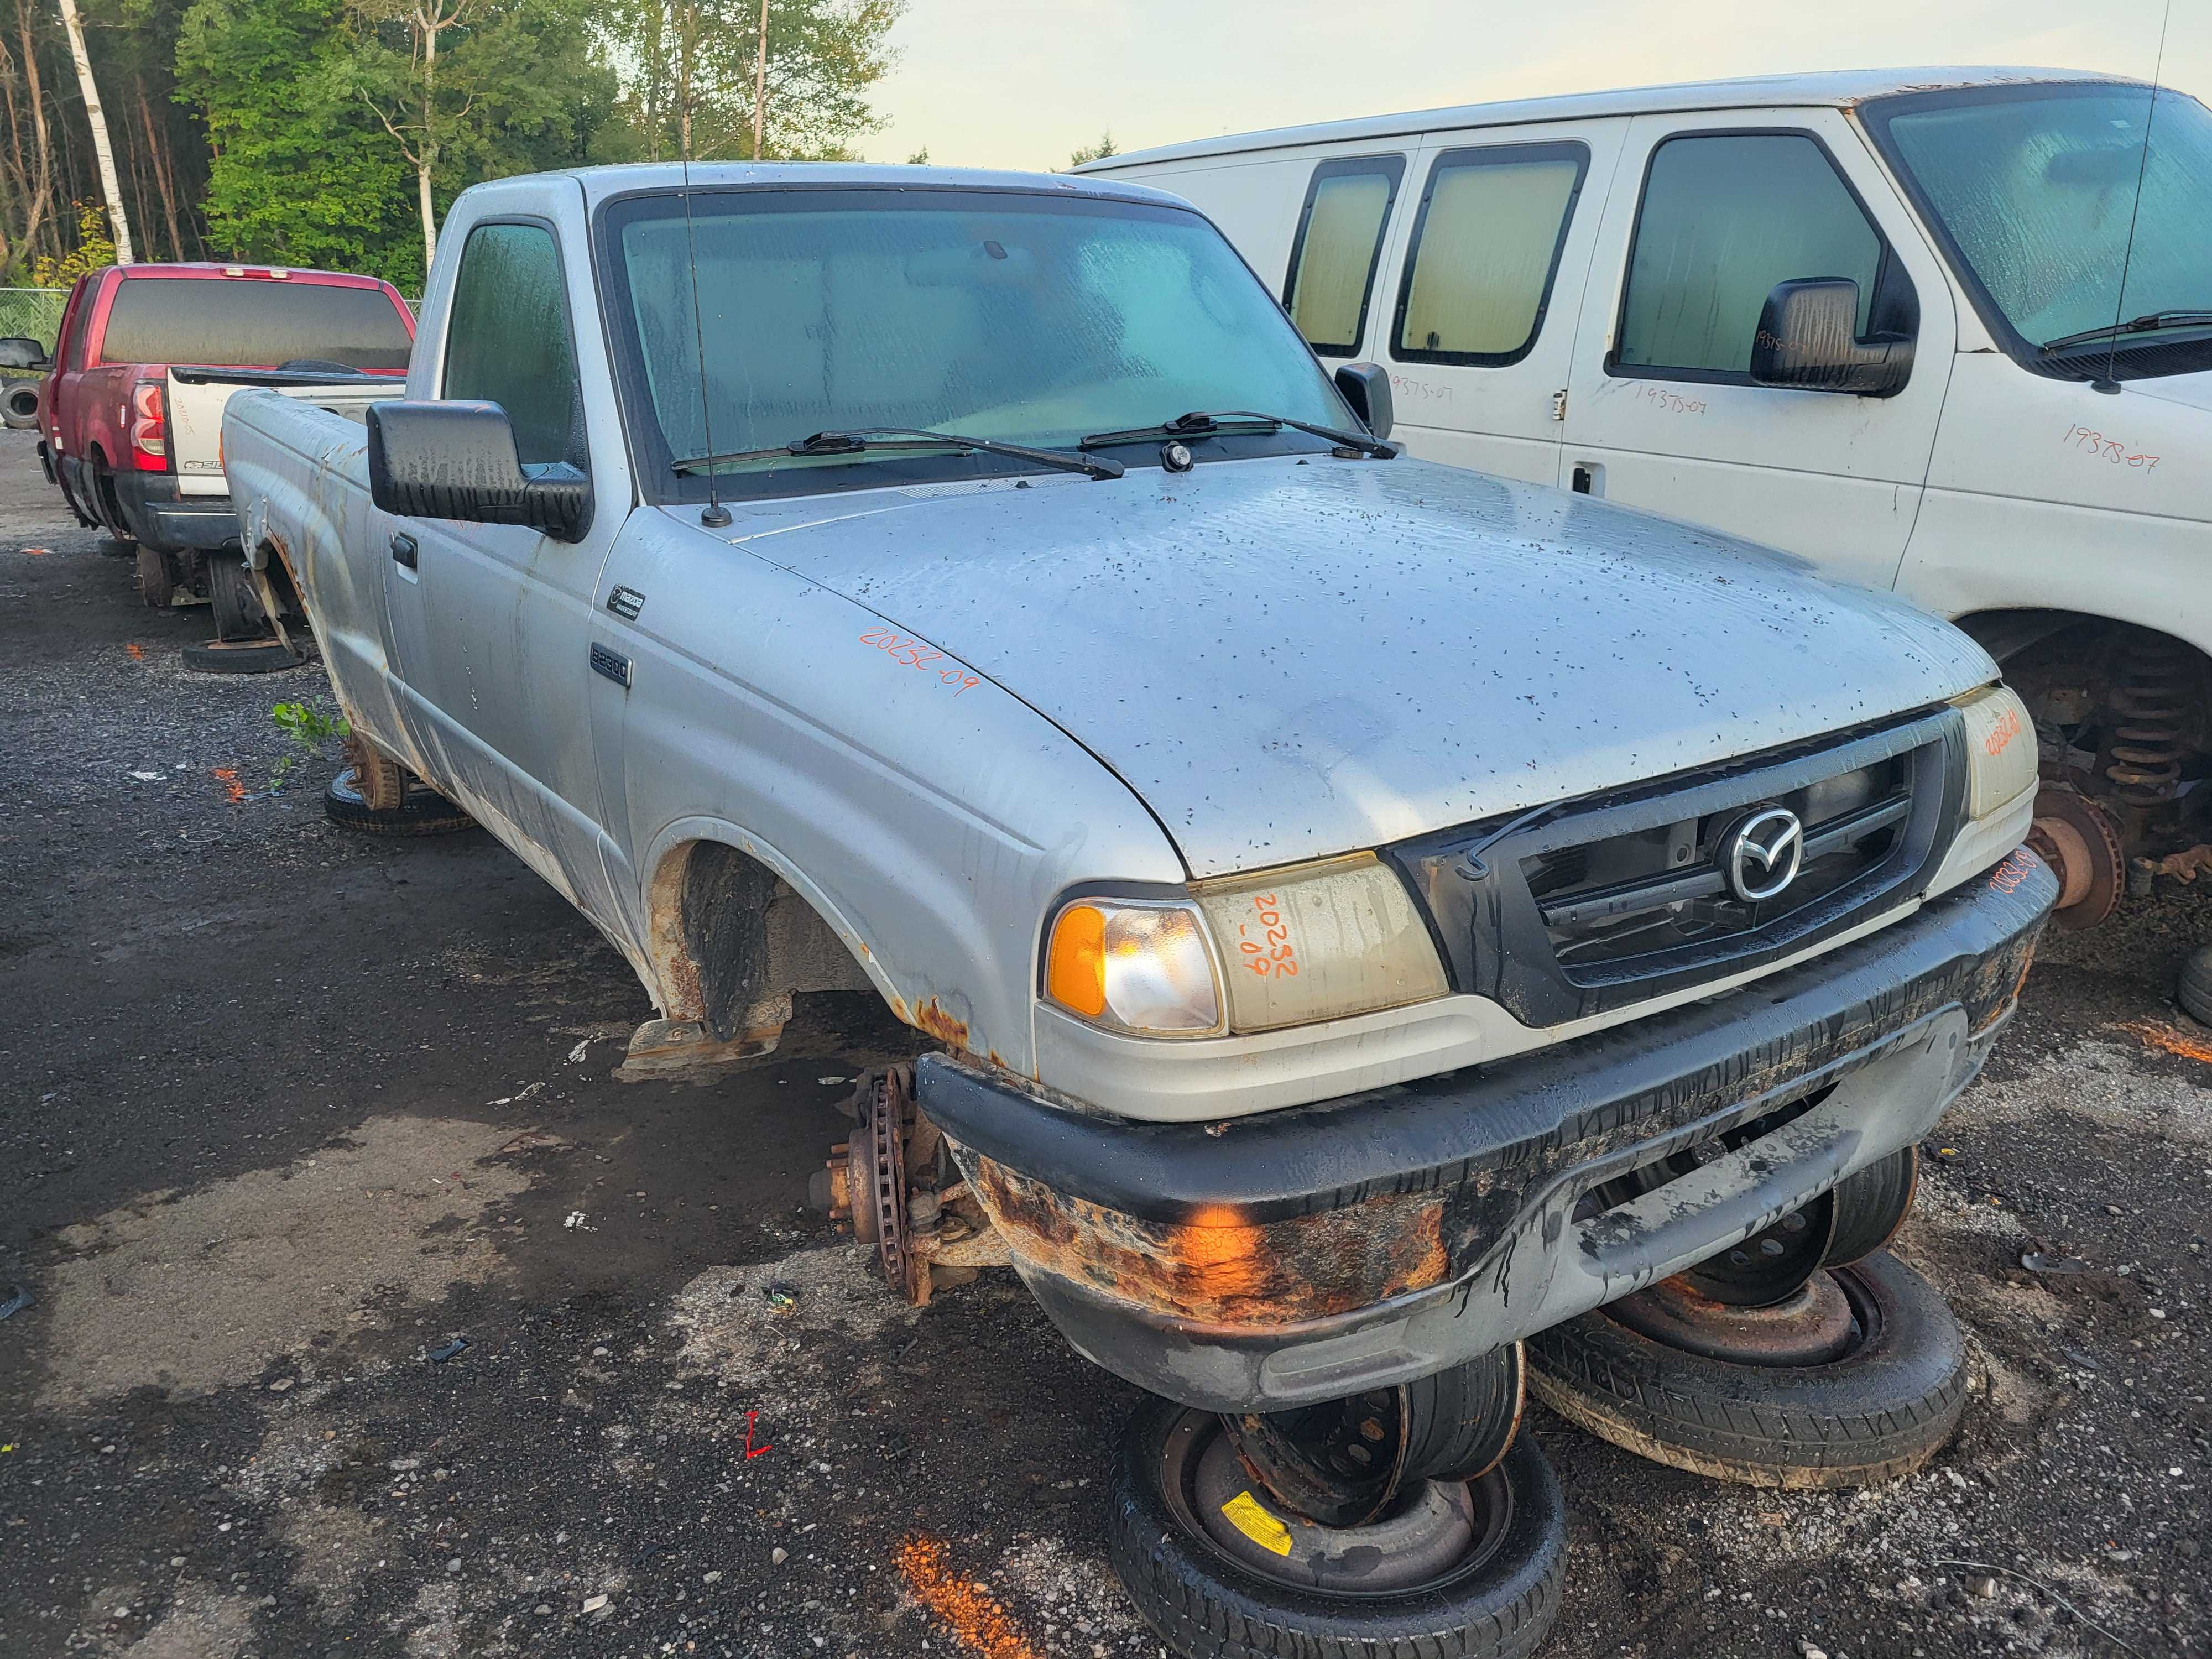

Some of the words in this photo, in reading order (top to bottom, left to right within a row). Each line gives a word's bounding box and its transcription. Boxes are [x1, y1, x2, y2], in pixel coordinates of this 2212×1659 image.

[1635, 385, 1707, 416] 19375-07
[591, 648, 626, 680] B2300
[1254, 893, 1298, 979] 20232
